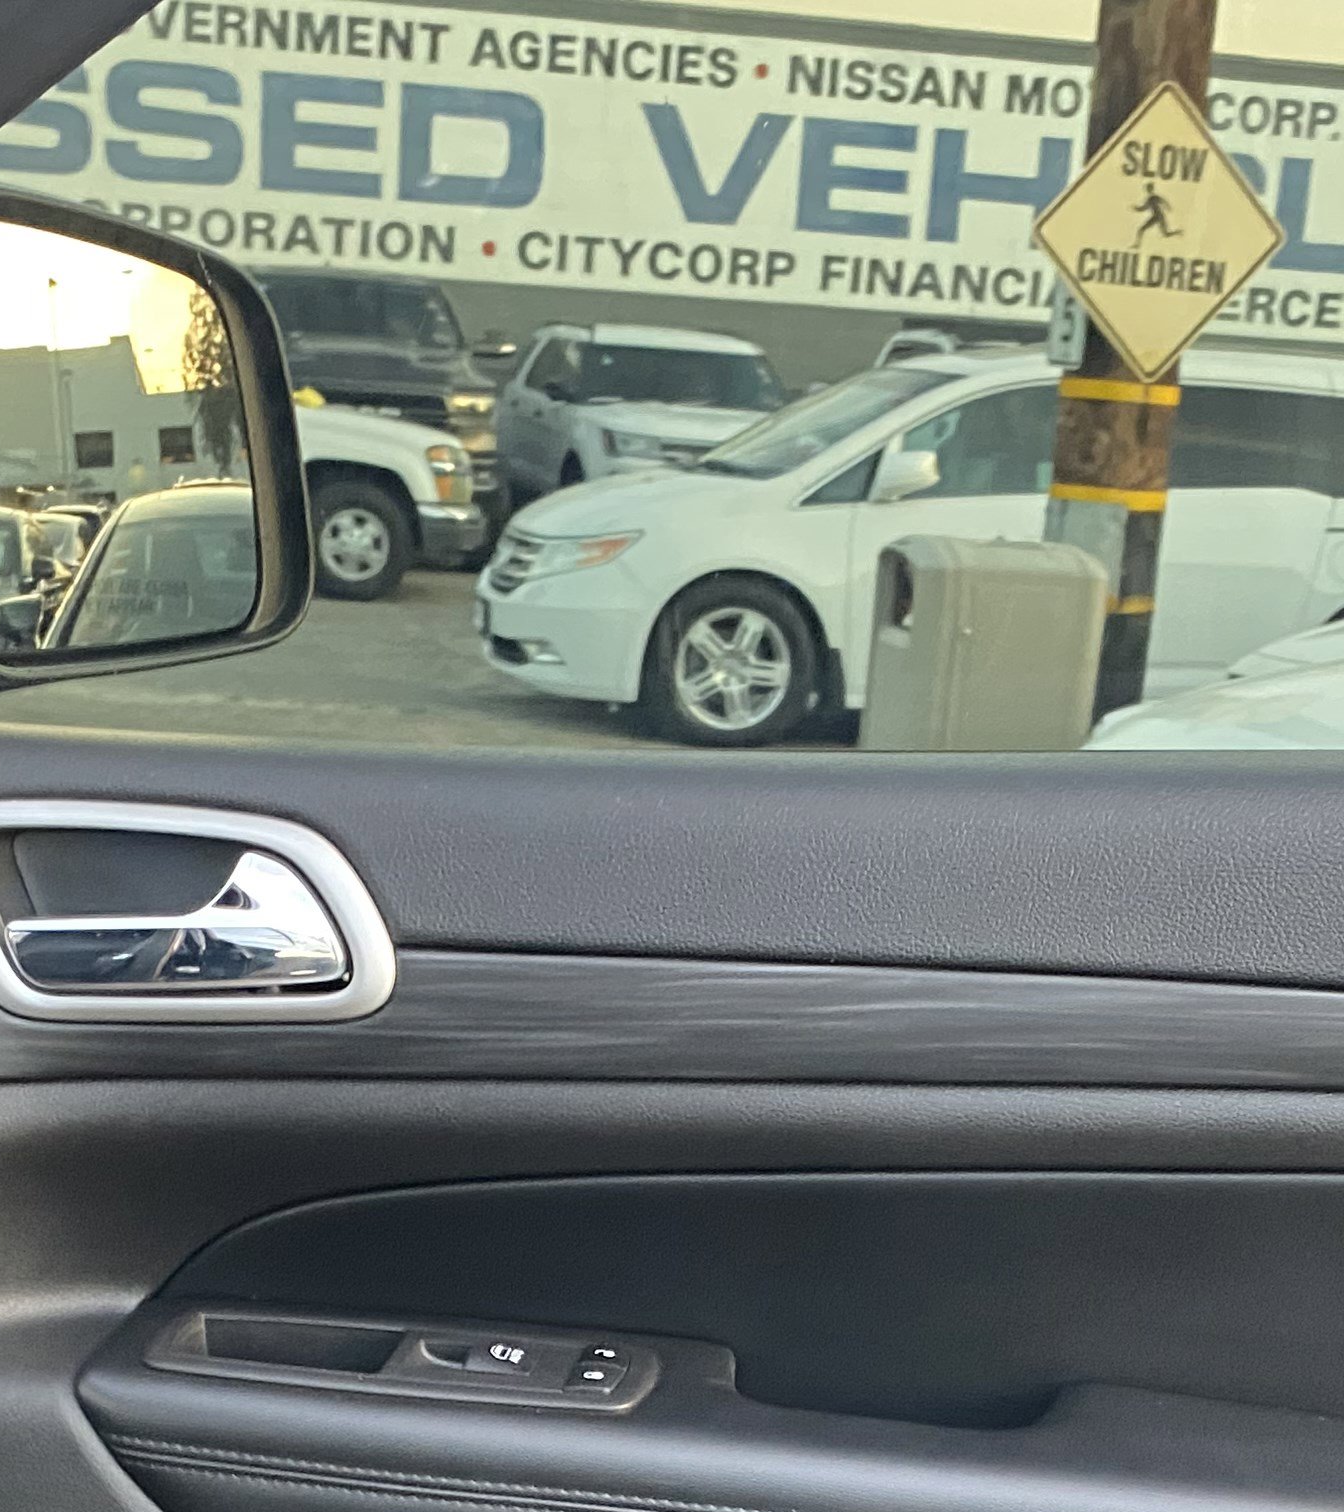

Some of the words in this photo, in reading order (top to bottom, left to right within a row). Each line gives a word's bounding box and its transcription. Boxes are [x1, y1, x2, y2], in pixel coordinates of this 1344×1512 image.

[148, 0, 451, 62] VERNMENT
[469, 27, 738, 88] AGENCIES
[786, 53, 987, 112] NISSAN
[1207, 92, 1341, 141] CORP.
[1122, 140, 1208, 182] SLOW
[82, 199, 455, 263] RPORATION
[517, 230, 796, 288] CITYCORP
[1077, 247, 1227, 294] CHILDREN
